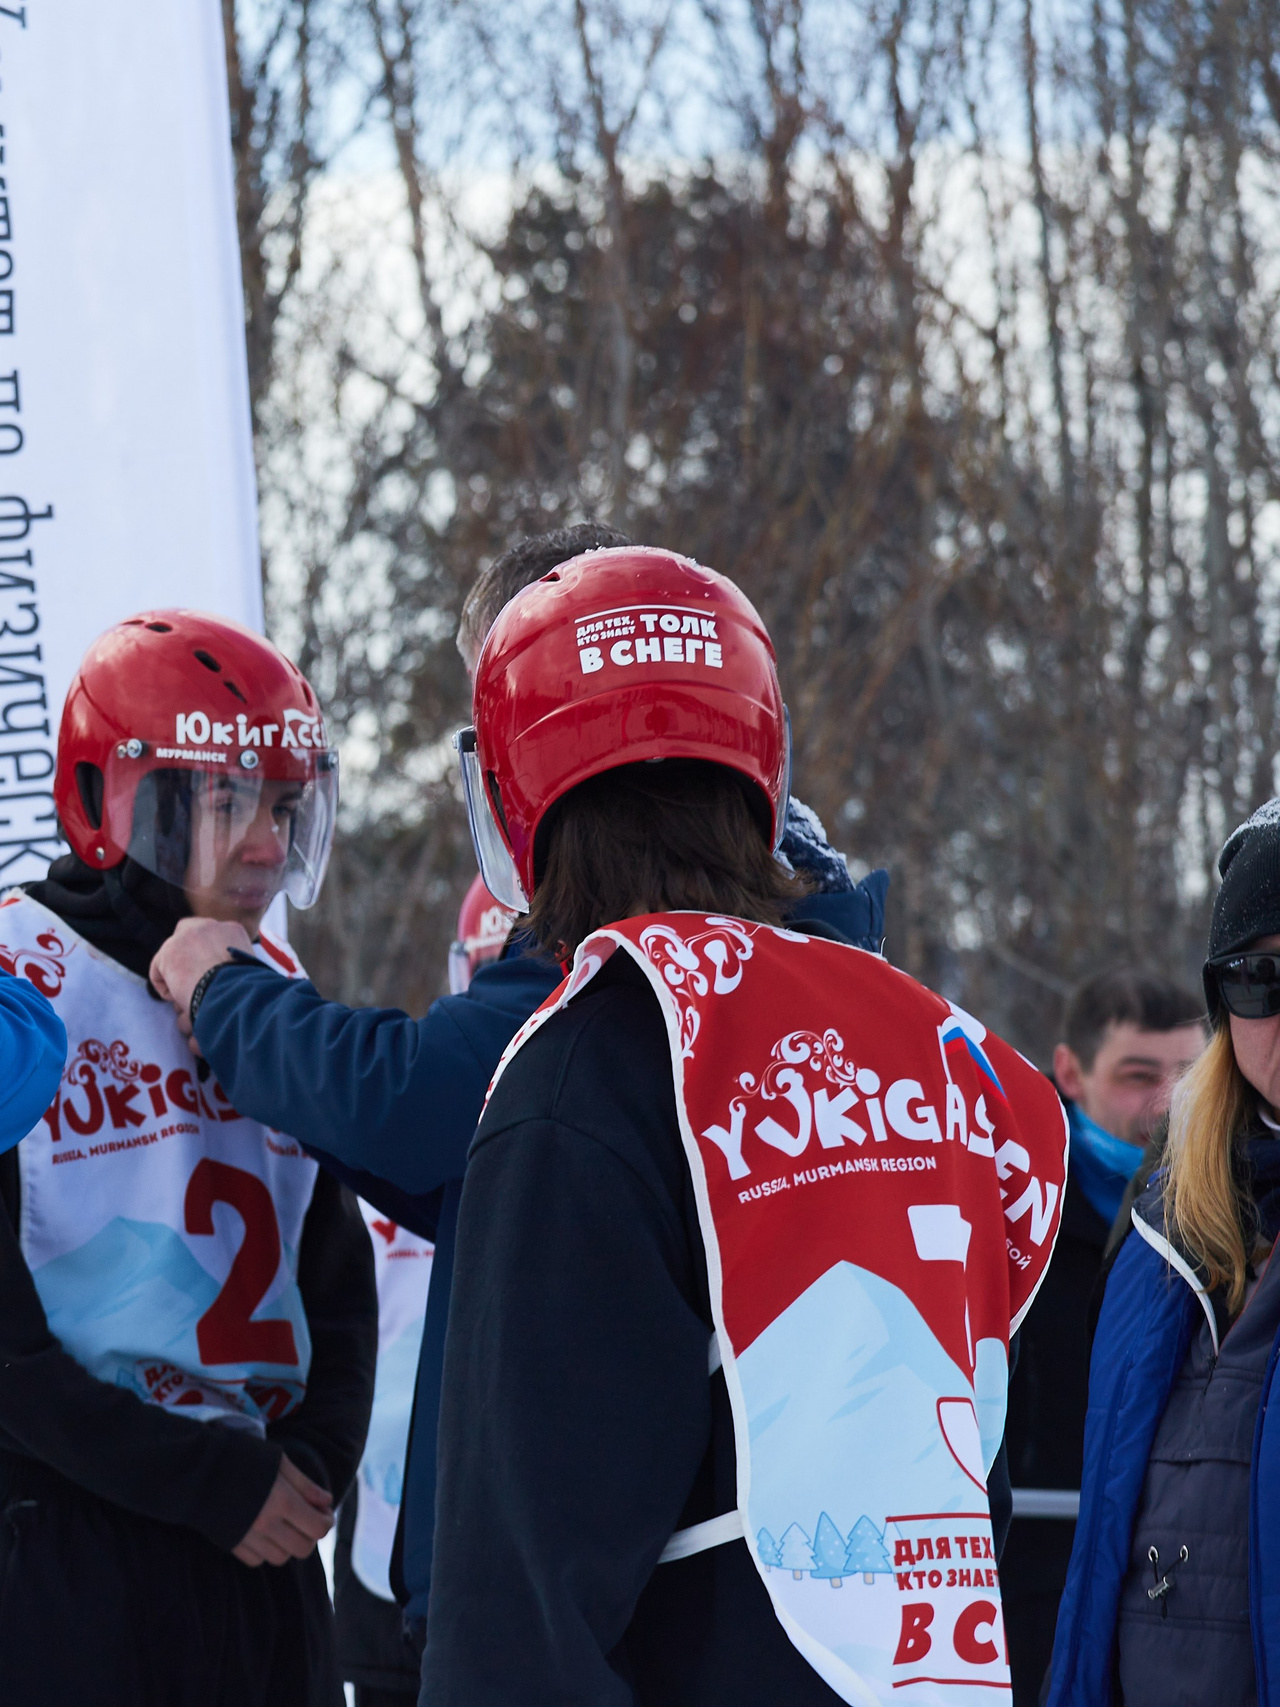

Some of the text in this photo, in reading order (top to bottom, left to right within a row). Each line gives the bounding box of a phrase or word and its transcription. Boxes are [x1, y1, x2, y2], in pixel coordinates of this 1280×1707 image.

[576, 613, 718, 639] ДЛЯ ТЕХ, ТОЛК
[576, 625, 636, 647] КТО ЗНАЕТ
[579, 637, 723, 674] В СНЕГЕ
[156, 747, 227, 763] МУРМАНСК
[89, 1131, 158, 1157] MURMANSK
[738, 1156, 937, 1204] RUSSIA, MURMANSK REGION
[183, 1157, 299, 1366] 2
[894, 1537, 952, 1566] ДЛЯ
[896, 1569, 943, 1591] КТО
[893, 1602, 935, 1665] В
